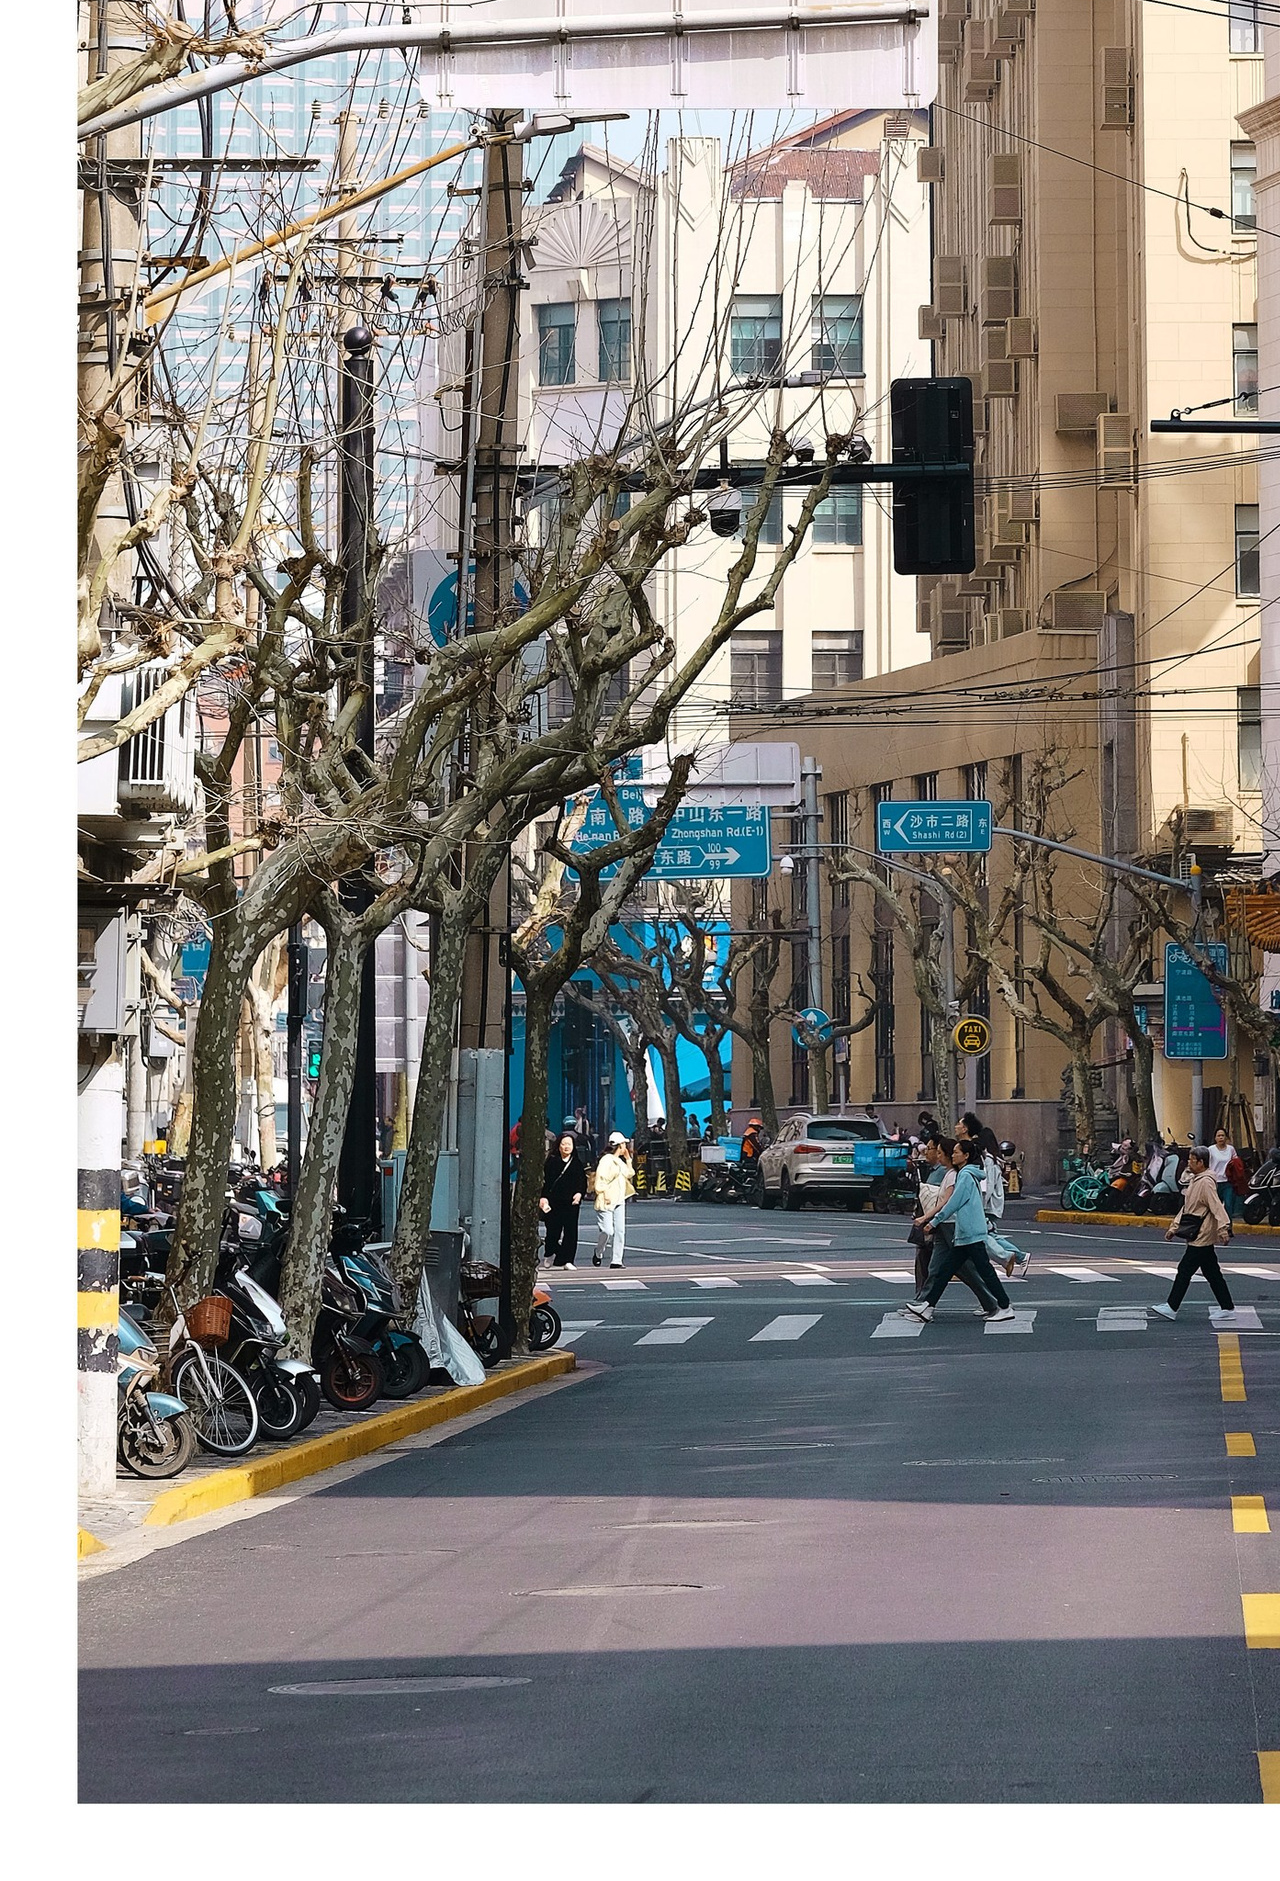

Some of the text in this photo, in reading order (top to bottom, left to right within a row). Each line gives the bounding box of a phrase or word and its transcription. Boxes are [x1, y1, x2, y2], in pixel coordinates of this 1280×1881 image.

[882, 819, 891, 828] 西
[910, 814, 969, 828] 沙市二路
[978, 818, 987, 828] 东
[671, 828, 723, 841] Zhongshan
[912, 830, 941, 839] Shashi
[707, 843, 721, 853] 100
[709, 860, 721, 870] 99
[963, 1025, 982, 1033] TAXI
